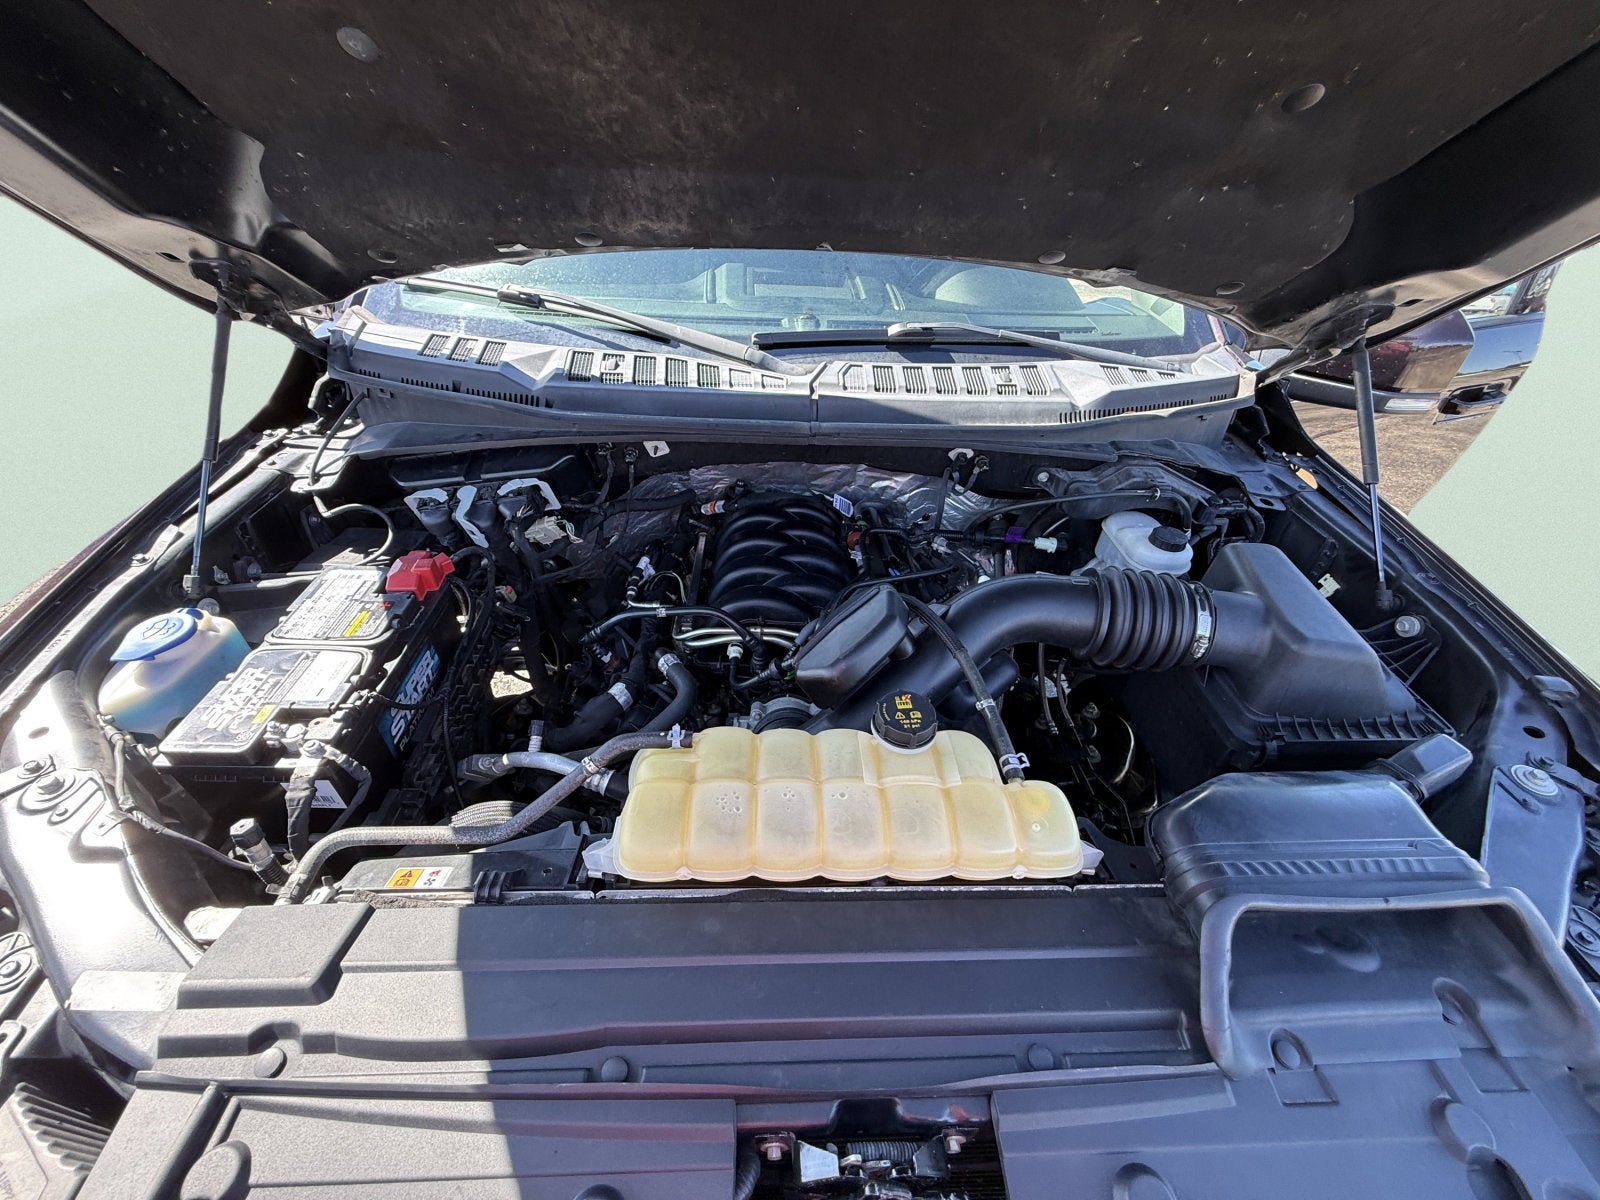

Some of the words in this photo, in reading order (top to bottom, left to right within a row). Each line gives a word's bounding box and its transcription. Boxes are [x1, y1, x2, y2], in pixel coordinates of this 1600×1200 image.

[201, 667, 260, 720] SUPER
[207, 668, 273, 731] START
[390, 660, 435, 745] START
[391, 650, 434, 717] SUPER
[400, 686, 435, 752] PLATINM
